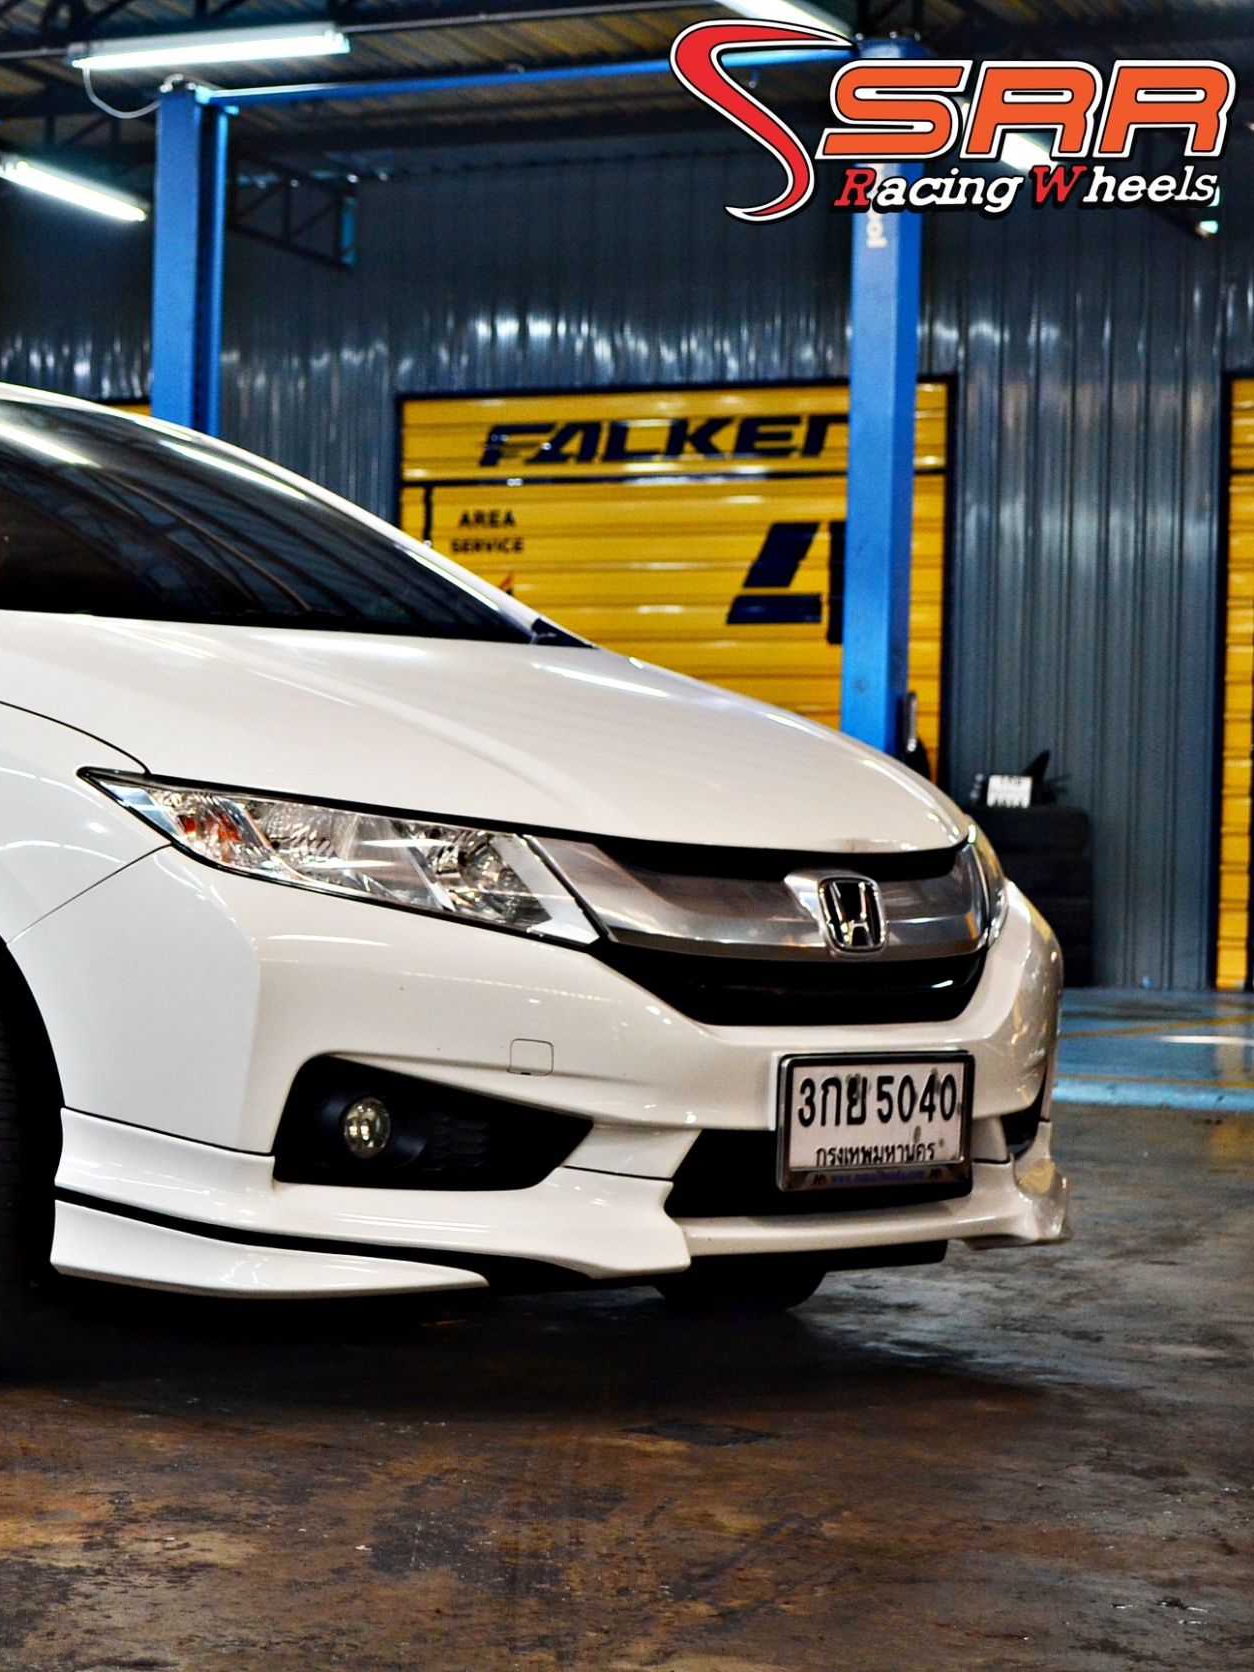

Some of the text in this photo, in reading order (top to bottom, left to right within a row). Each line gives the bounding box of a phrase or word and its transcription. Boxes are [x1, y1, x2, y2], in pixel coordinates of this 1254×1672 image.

[458, 509, 516, 529] AREA
[450, 536, 524, 555] SERVICE
[876, 1073, 957, 1124] 5040
[815, 1142, 936, 1168] กรงเทพมหานคร
